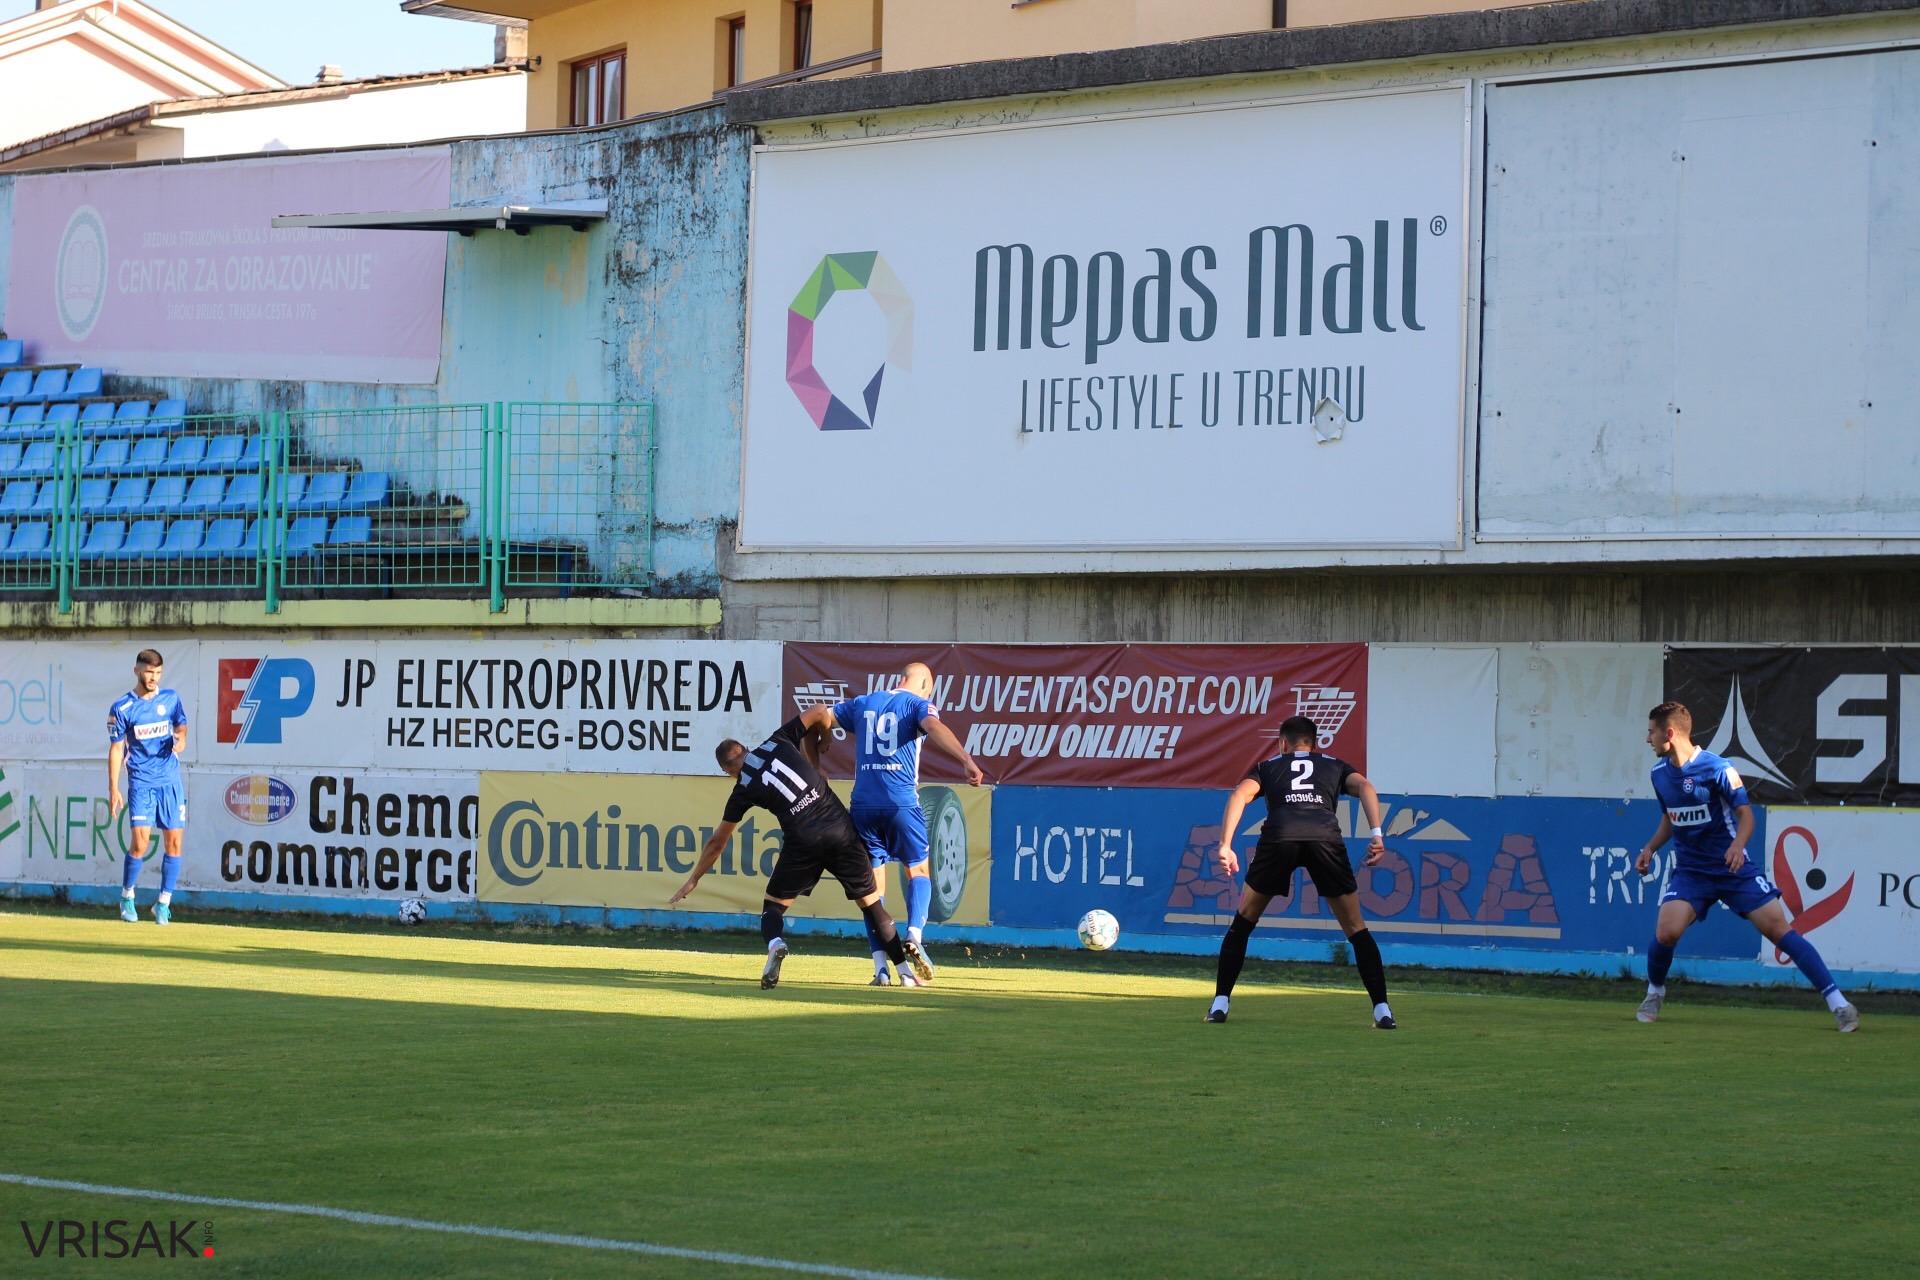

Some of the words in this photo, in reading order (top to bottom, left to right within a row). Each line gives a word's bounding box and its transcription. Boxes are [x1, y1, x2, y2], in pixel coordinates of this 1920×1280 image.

[118, 257, 189, 294] CENTAR
[193, 256, 218, 292] ZA
[224, 253, 372, 292] OBRAZOVANJE
[1021, 372, 1185, 433] LIFESTYLE
[1201, 371, 1221, 428] U
[1232, 365, 1365, 427] TRENDU
[217, 657, 315, 744] EP
[336, 658, 376, 708] JP
[397, 657, 753, 713] ELEKTROPRIVREDA
[387, 717, 425, 748] HZ
[434, 717, 691, 753] HERCEG-BOSNE
[863, 710, 899, 757] 19
[965, 723, 1059, 758] KUPUJ
[1059, 724, 1183, 760] ONLINE!
[761, 757, 808, 804] 11
[1291, 759, 1315, 790] 2
[310, 776, 479, 840] Chemo
[221, 839, 478, 895] commerce
[1013, 824, 1145, 887] HOTEL
[1754, 875, 1771, 894] 8
